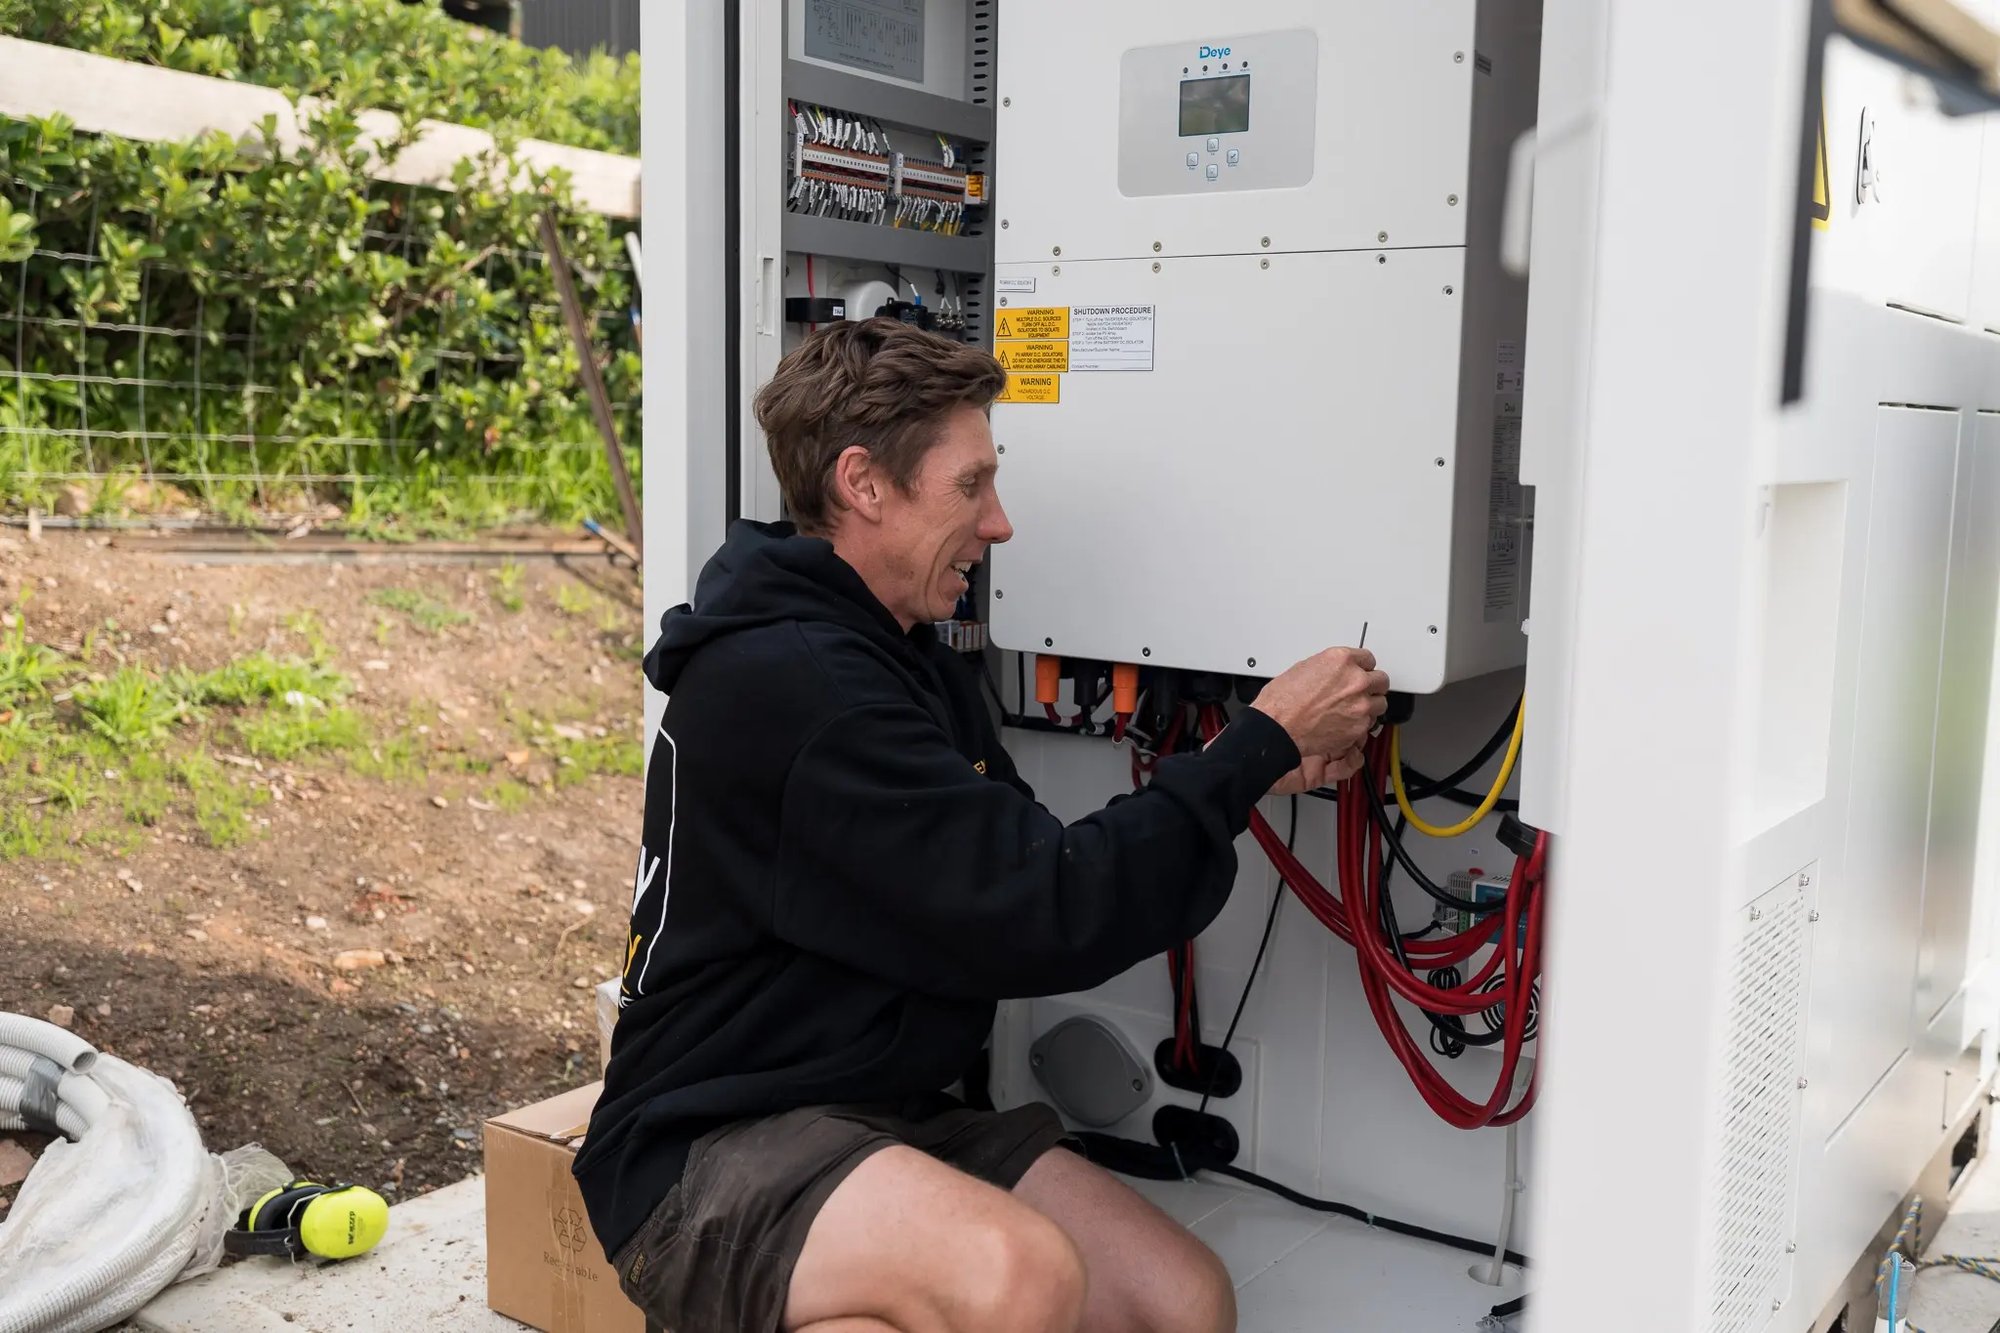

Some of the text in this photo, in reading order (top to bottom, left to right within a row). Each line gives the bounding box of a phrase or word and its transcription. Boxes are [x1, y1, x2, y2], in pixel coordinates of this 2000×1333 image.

[1200, 46, 1231, 59] Deye
[1073, 306, 1151, 316] SHUTDOWN PROCEDURE
[1020, 378, 1052, 386] WARNING
[543, 1251, 599, 1282] Reccable
